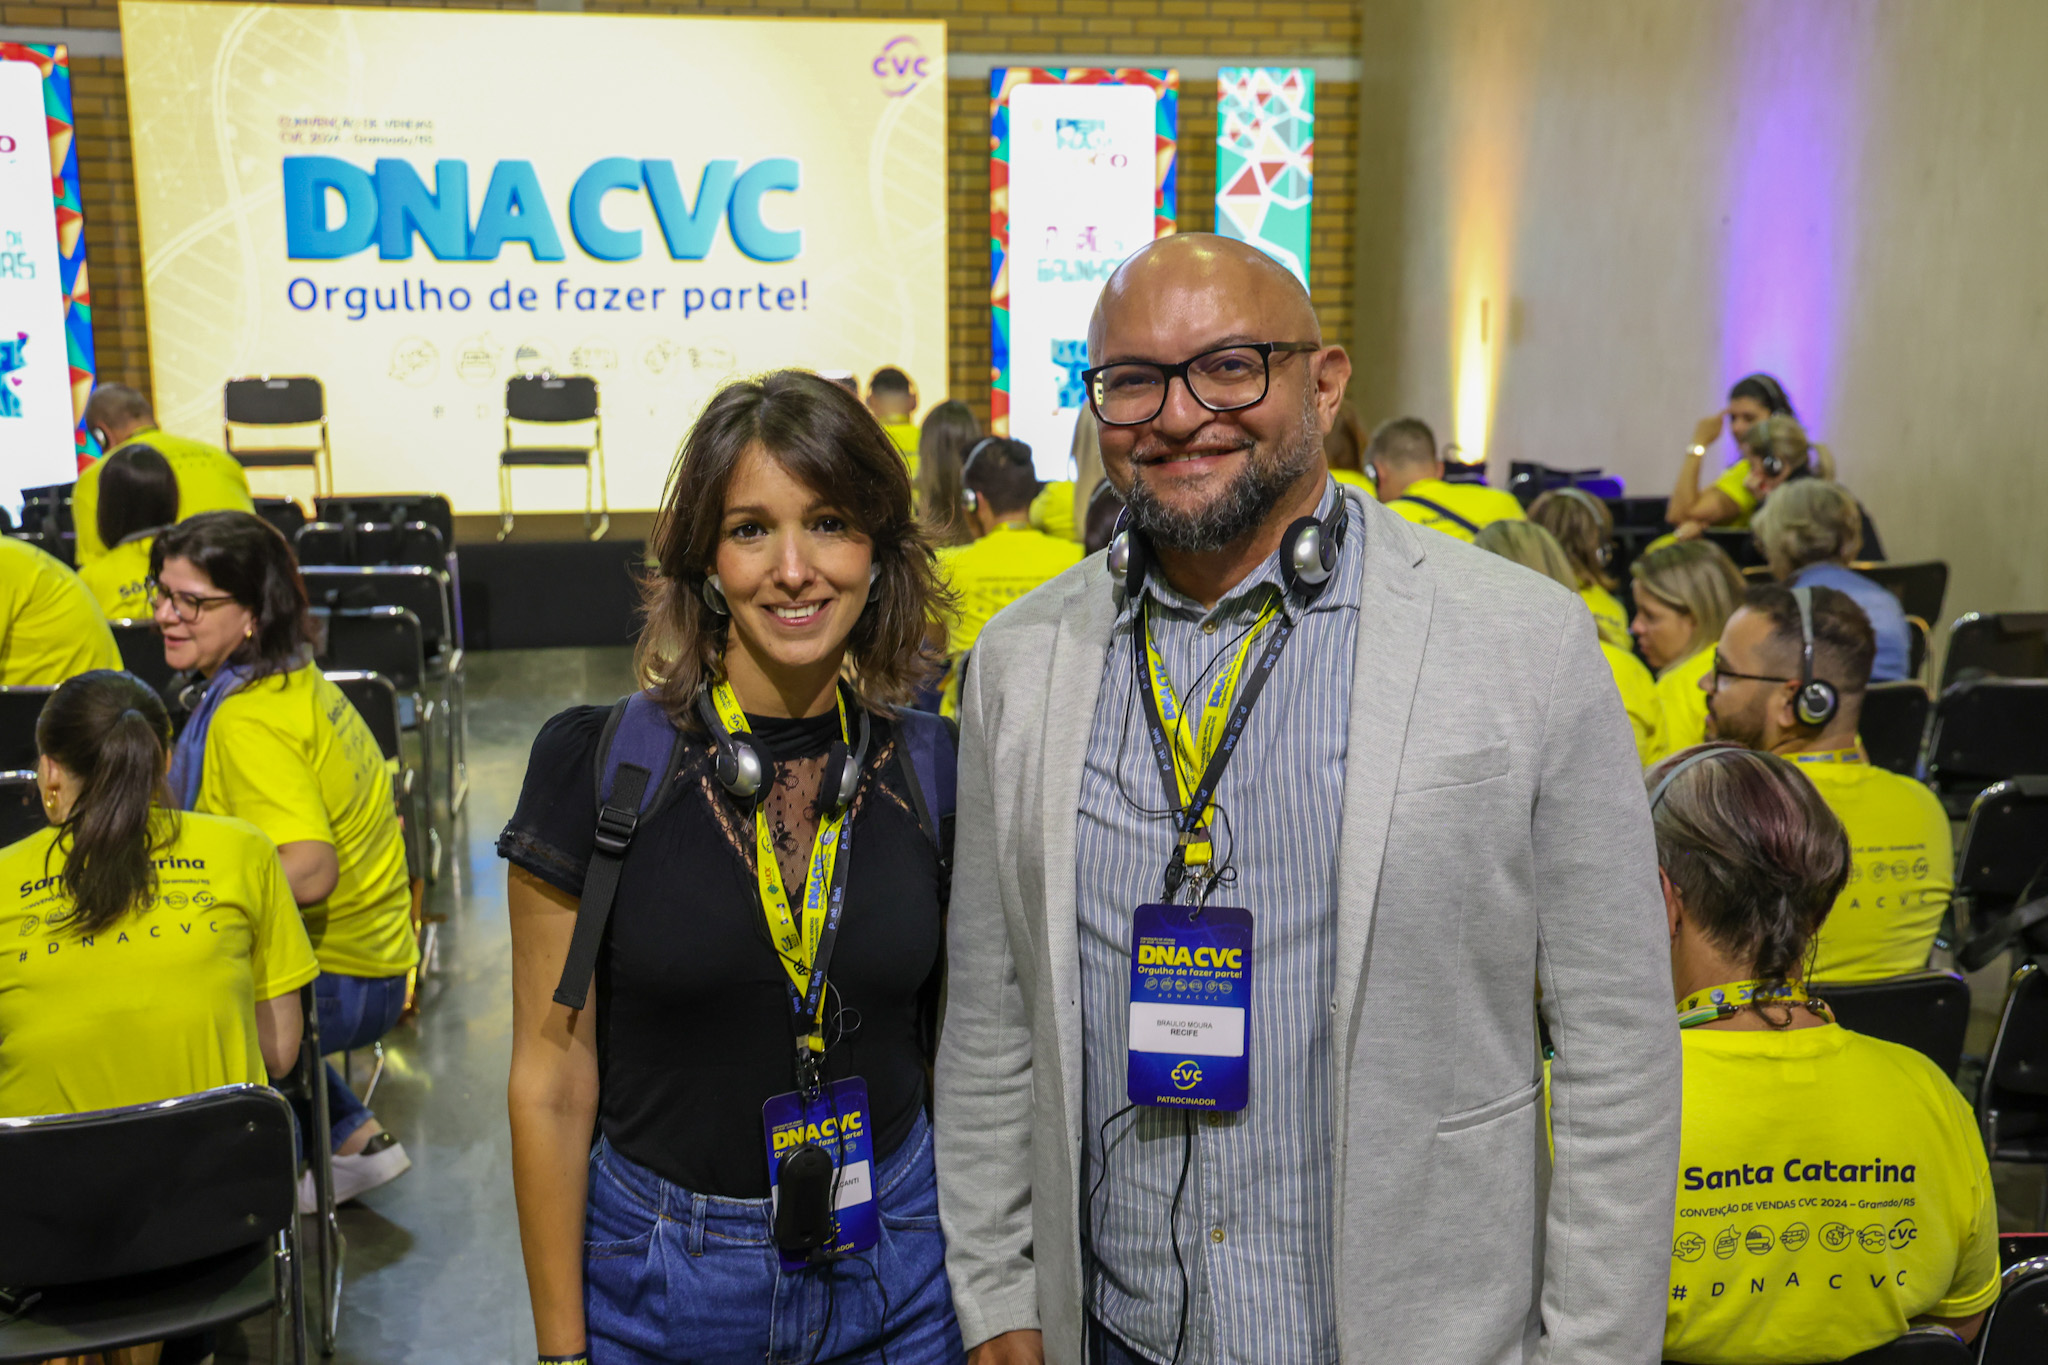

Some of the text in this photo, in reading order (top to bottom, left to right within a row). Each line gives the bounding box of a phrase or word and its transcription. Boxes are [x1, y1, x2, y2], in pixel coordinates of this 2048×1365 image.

[283, 156, 802, 262] DNA CVC
[287, 277, 809, 321] Orgulho de fazer parte!
[20, 855, 205, 899] San rina
[1138, 945, 1242, 969] DNA CVC
[1137, 965, 1243, 979] Orgulho de fazer parte!
[1156, 1019, 1213, 1030] BRAULIO MOURA
[1170, 1028, 1199, 1037] RECIFE
[1156, 1095, 1217, 1106] PATROCINADOR
[772, 1123, 822, 1151] DNA
[838, 1177, 860, 1188] CANTI
[1684, 1157, 1916, 1191] Santa Catarina
[1679, 1203, 1740, 1218] CONVENÇÃO
[1741, 1202, 1754, 1212] DE
[1755, 1199, 1797, 1210] VENDAS
[1798, 1197, 1818, 1208] CVC
[1820, 1198, 1848, 1208] 2024
[1857, 1197, 1916, 1209] Gramado/RS
